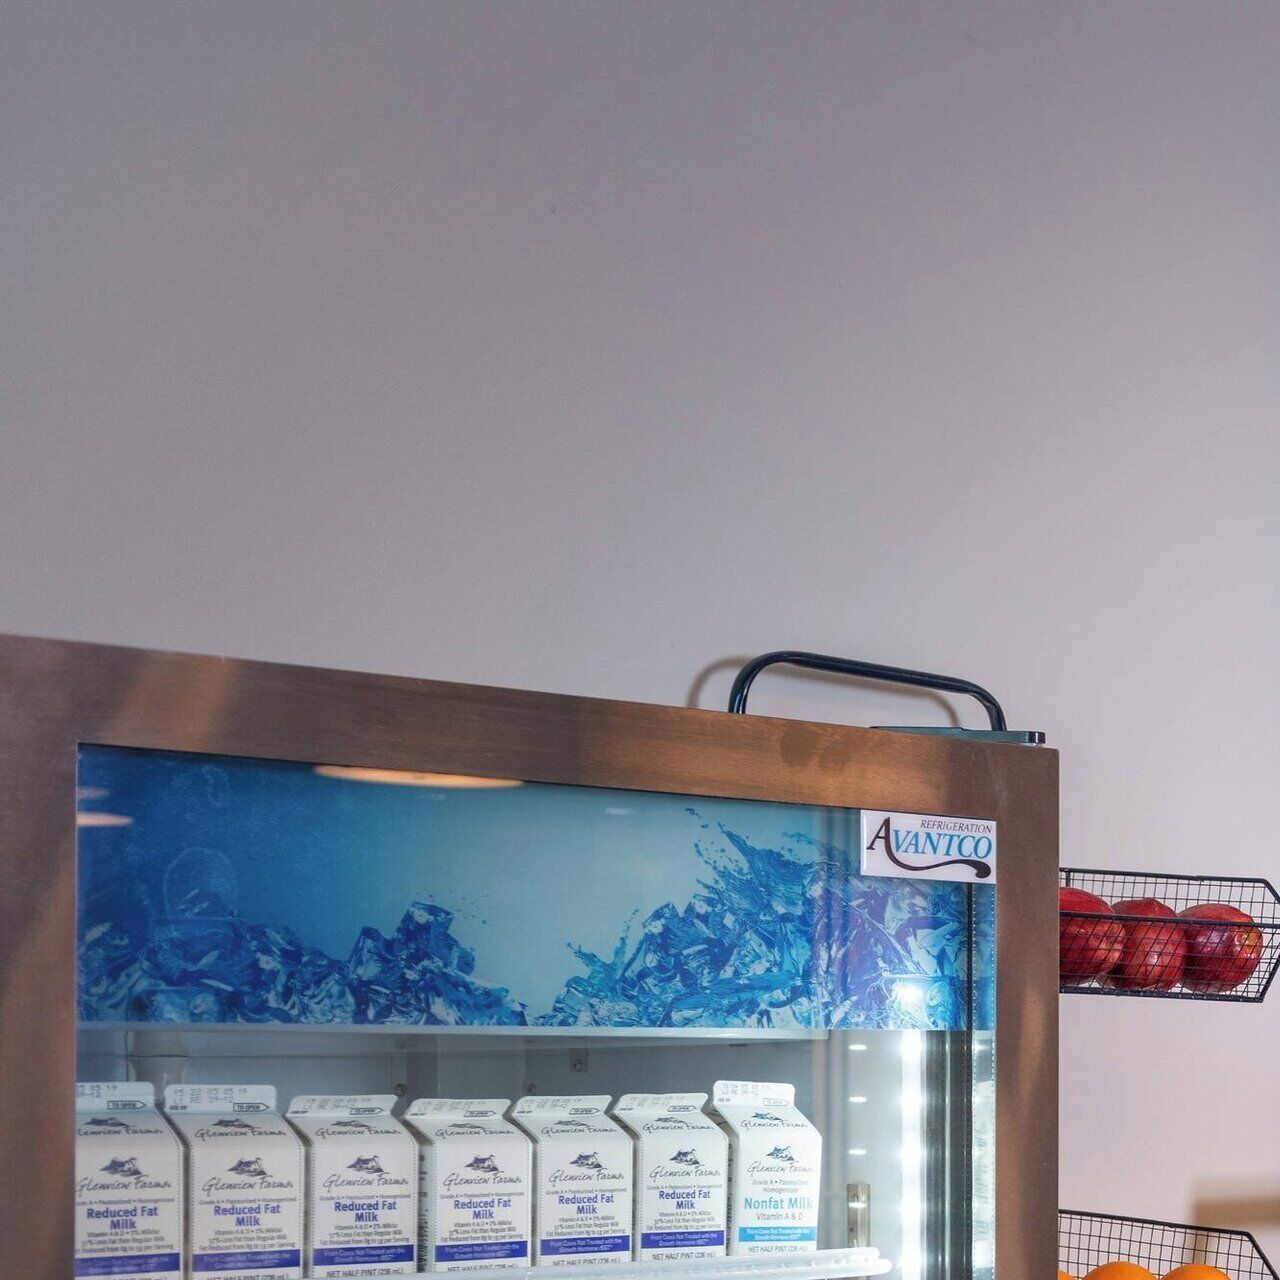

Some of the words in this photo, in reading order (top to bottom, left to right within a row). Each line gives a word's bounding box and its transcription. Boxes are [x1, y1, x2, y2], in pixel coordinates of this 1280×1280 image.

[920, 819, 992, 833] REFRIGERATION
[866, 816, 992, 864] AVANTCO
[558, 1194, 598, 1204] Reduced
[601, 1194, 614, 1203] Fat
[659, 1190, 696, 1199] Reduced
[698, 1190, 711, 1198] Fat
[334, 1200, 379, 1211] Reduced
[382, 1200, 397, 1210] Fat
[453, 1199, 494, 1209] Reduced
[498, 1198, 512, 1207] Fat
[676, 1200, 695, 1210] Milk
[744, 1197, 784, 1209] Nonfat
[788, 1197, 813, 1209] Milk
[87, 1207, 137, 1219] Reduced
[141, 1206, 158, 1216] Fat
[214, 1204, 261, 1216] Reduced
[264, 1203, 281, 1214] Fat
[472, 1209, 494, 1220] Milk
[577, 1205, 598, 1214] Milk
[235, 1216, 261, 1226] Milk
[355, 1212, 378, 1222] Milk
[110, 1219, 137, 1230] Milk
